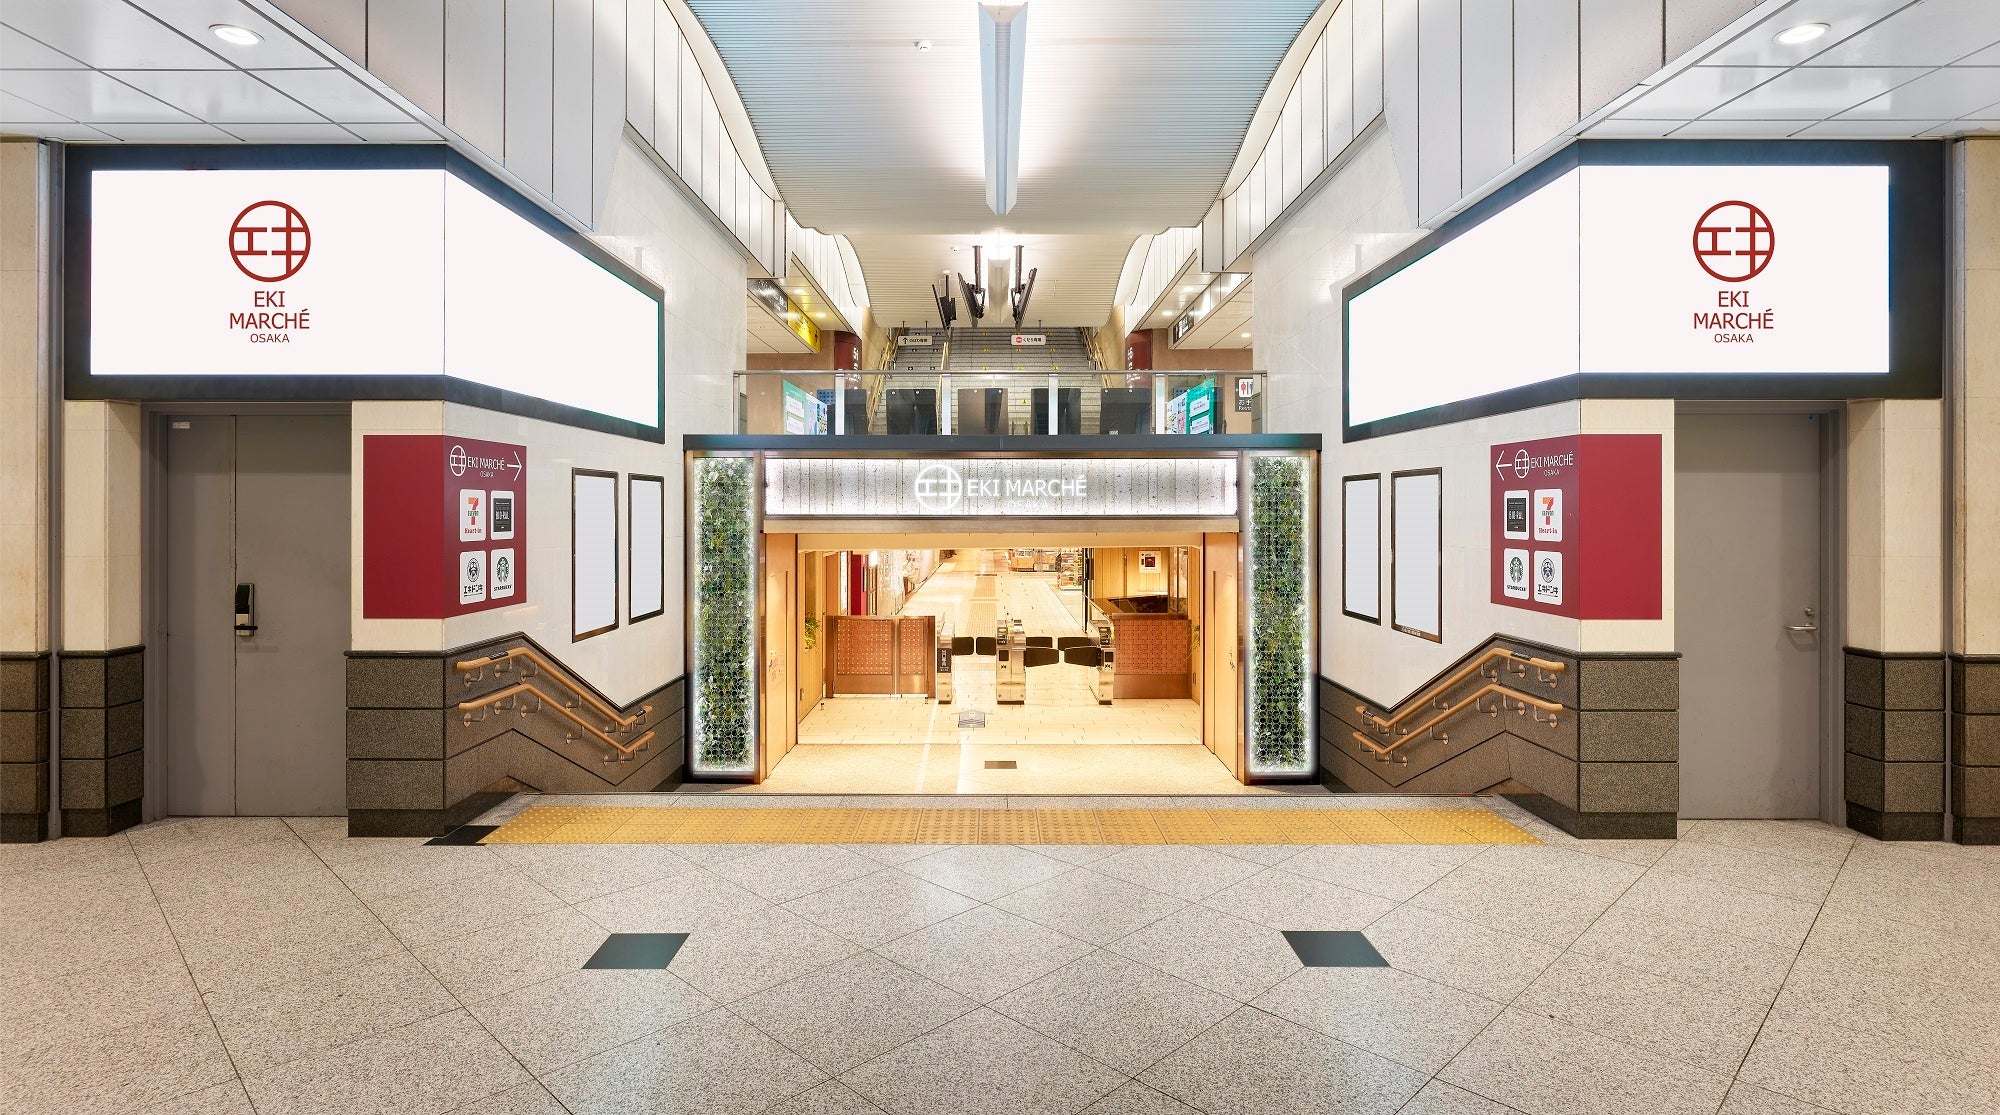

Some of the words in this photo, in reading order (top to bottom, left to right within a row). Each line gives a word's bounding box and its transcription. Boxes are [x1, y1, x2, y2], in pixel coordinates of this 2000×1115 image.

[254, 291, 286, 307] EKI
[1718, 291, 1750, 307] EKI
[229, 308, 310, 329] MARCHÉ
[1693, 308, 1774, 329] MARCHÉ
[250, 333, 290, 343] OSAKA
[1714, 333, 1754, 343] OSAKA
[467, 456, 479, 469] EKI
[479, 457, 505, 471] MARCHÉ
[1530, 456, 1542, 469] EKI
[1543, 450, 1574, 468] MARCHÉ
[967, 479, 1000, 497] EKI
[1006, 475, 1087, 497] MARCHÉ
[1007, 501, 1049, 510] OSAKA
